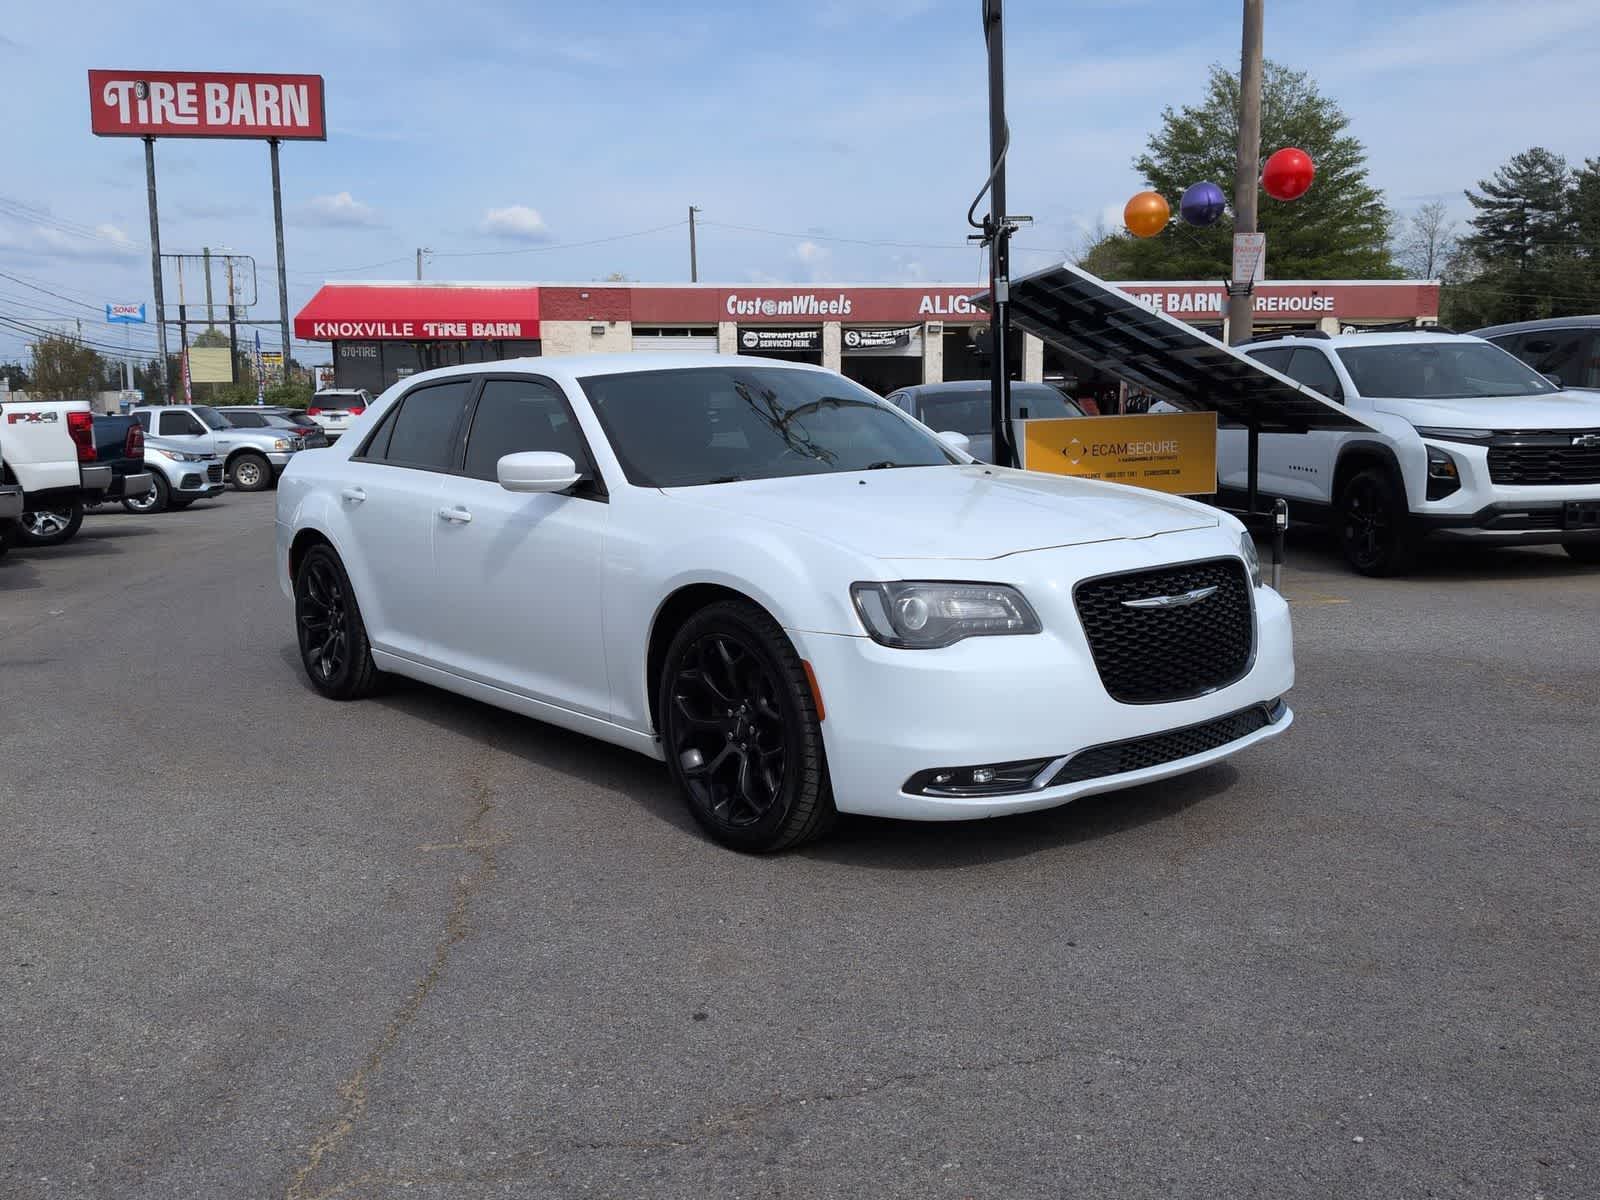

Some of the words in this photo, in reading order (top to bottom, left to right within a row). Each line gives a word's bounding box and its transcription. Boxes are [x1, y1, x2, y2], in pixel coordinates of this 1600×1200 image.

[204, 83, 310, 127] BARN
[1166, 293, 1222, 312] BARN
[1252, 297, 1334, 311] REHOUSE
[313, 322, 414, 337] KNOXVILLE
[472, 323, 521, 337] BARN
[759, 340, 792, 348] SERVICED
[793, 340, 811, 348] HERE
[7, 412, 58, 424] FX4
[1091, 440, 1178, 457] ECAMSECURE
